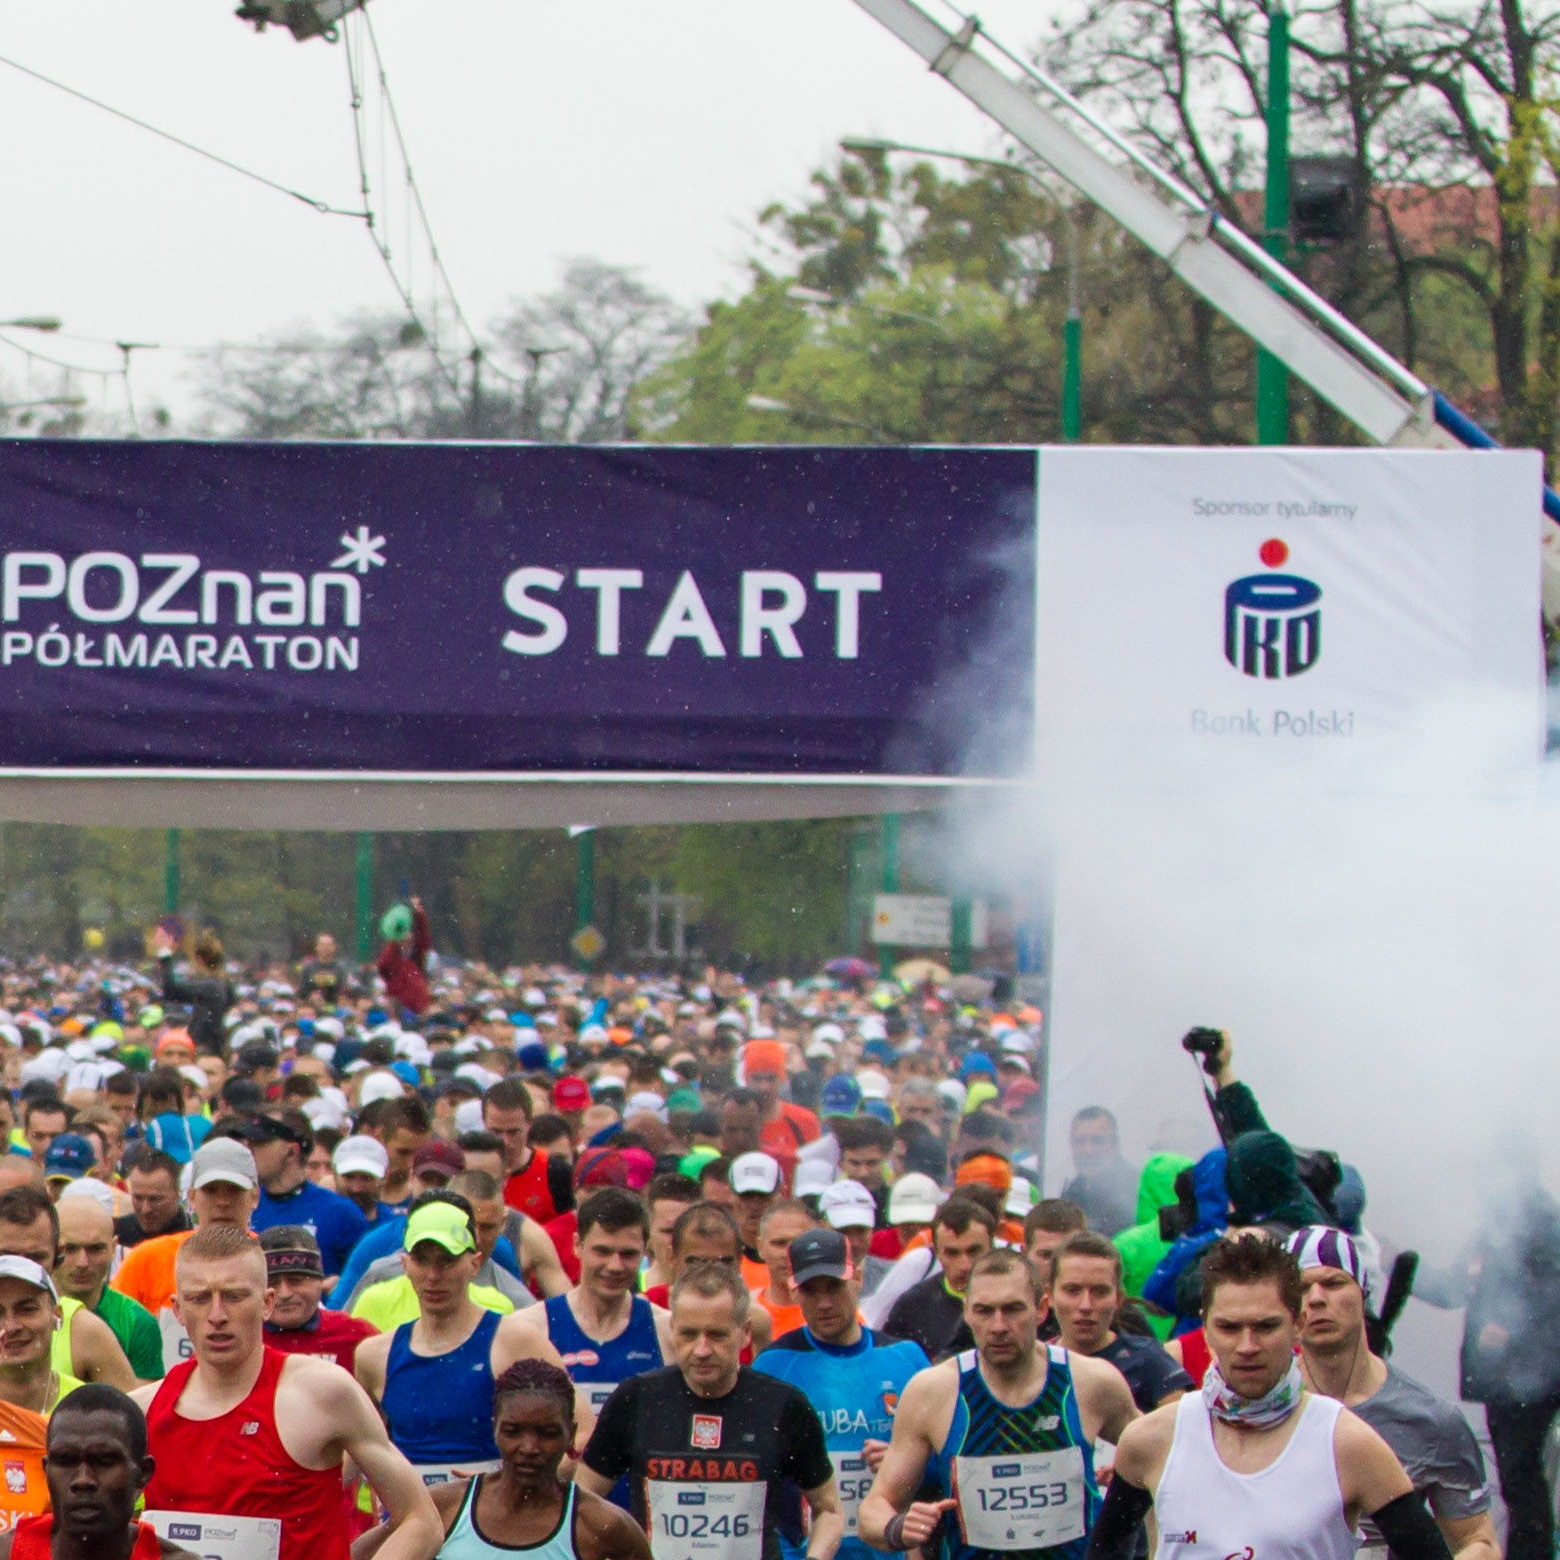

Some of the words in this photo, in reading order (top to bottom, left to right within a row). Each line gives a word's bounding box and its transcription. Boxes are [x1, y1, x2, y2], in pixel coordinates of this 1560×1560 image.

[1192, 498, 1270, 518] Sponsor
[502, 565, 882, 659] START
[1, 622, 360, 671] PÓŁMARATON
[1191, 709, 1261, 737] Bank
[1274, 709, 1355, 737] Polski
[646, 1460, 758, 1481] STRABAG
[977, 1482, 1068, 1512] 12553
[661, 1512, 750, 1538] 10246
